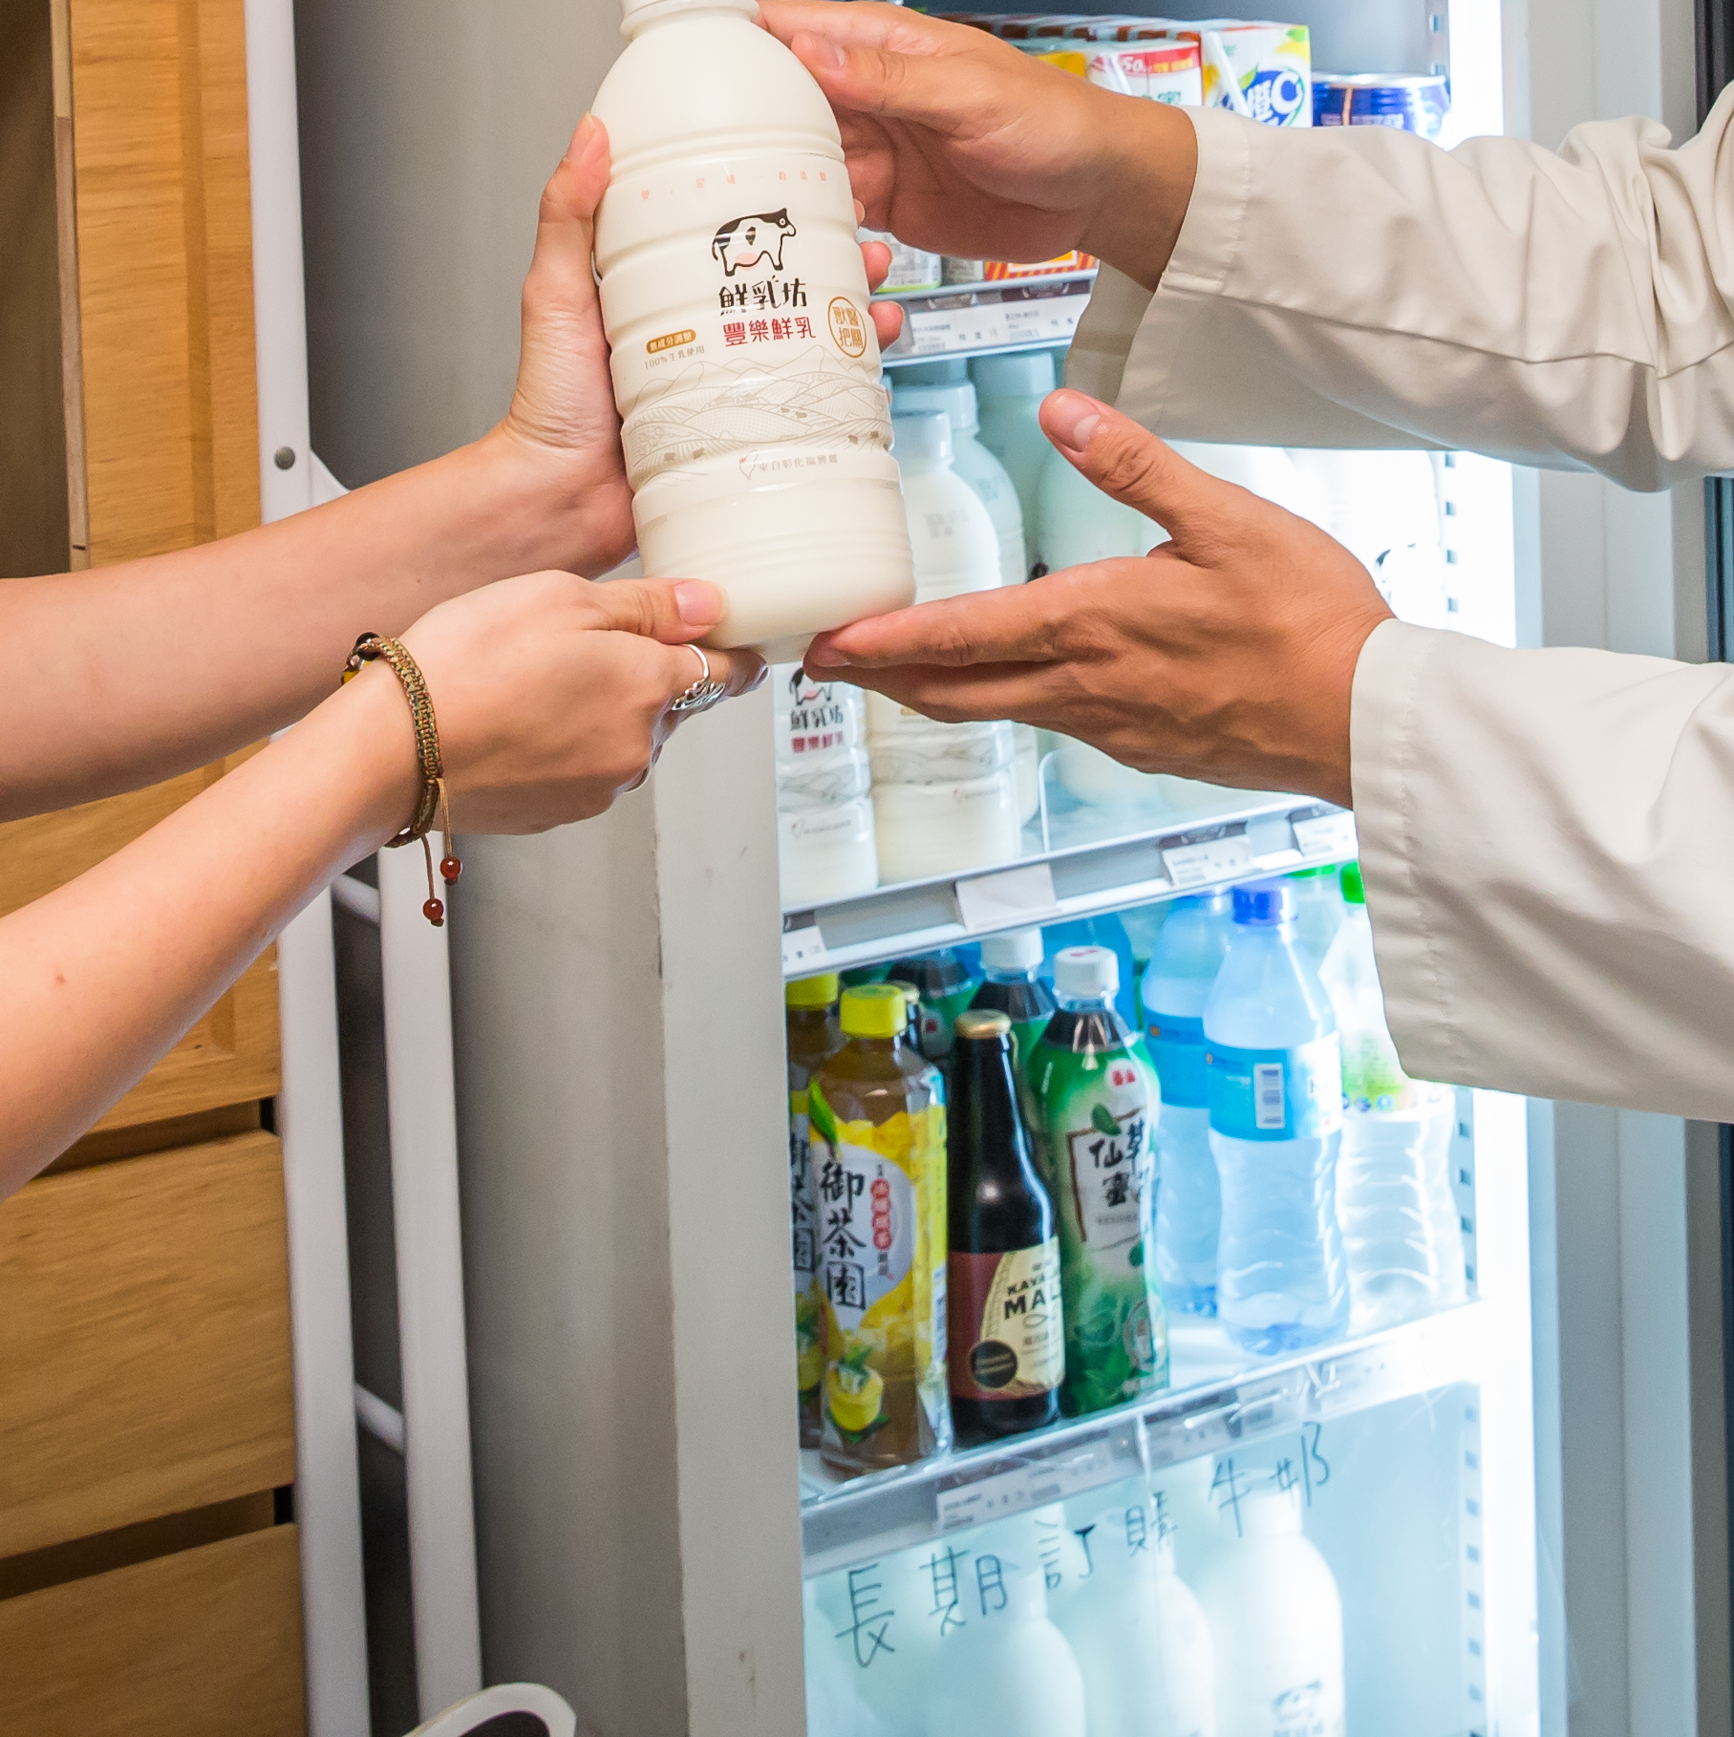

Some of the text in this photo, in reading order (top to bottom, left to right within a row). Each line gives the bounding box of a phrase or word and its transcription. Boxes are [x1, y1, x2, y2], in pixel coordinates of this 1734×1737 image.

[719, 275, 808, 316] 鮮乳坊
[723, 316, 816, 348] 豐樂鮮乳
[819, 1160, 867, 1311] 御茶園
